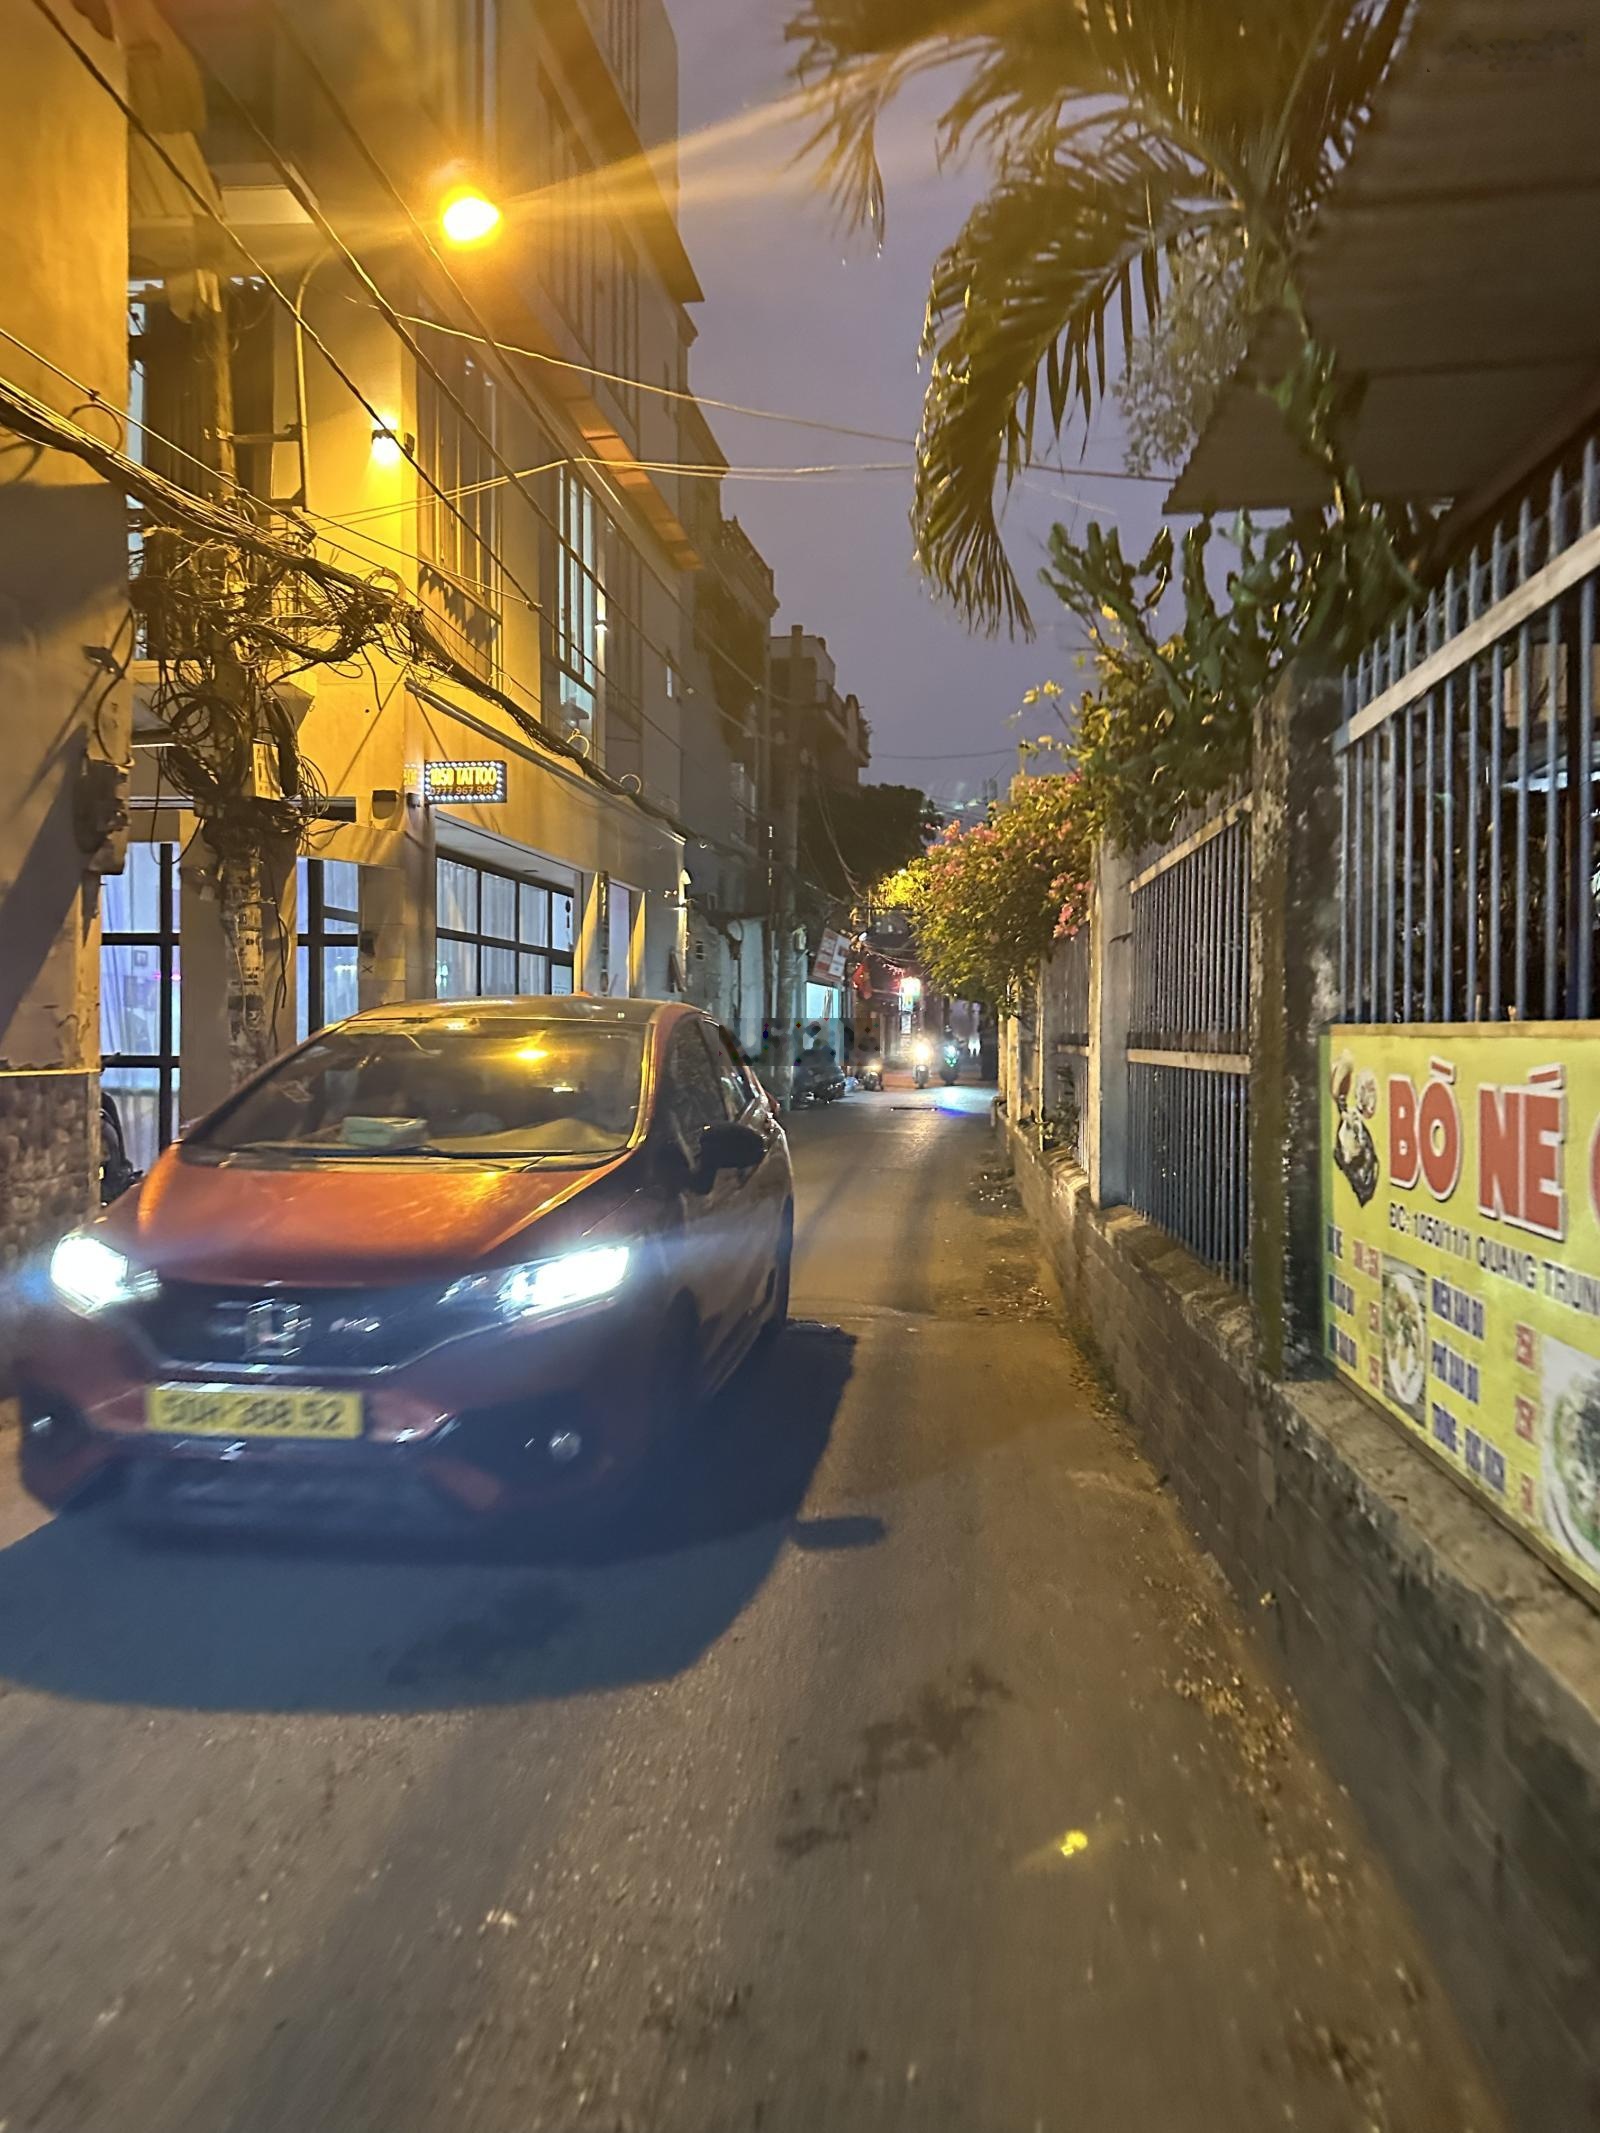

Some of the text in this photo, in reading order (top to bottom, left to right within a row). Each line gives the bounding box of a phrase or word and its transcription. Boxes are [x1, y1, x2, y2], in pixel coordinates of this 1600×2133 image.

[456, 766, 497, 786] TATTOO
[1388, 1056, 1461, 1201] BÒ
[1478, 1062, 1566, 1243] NÉ
[1476, 1235, 1537, 1291] QUANG
[1542, 1259, 1600, 1317] TRUN
